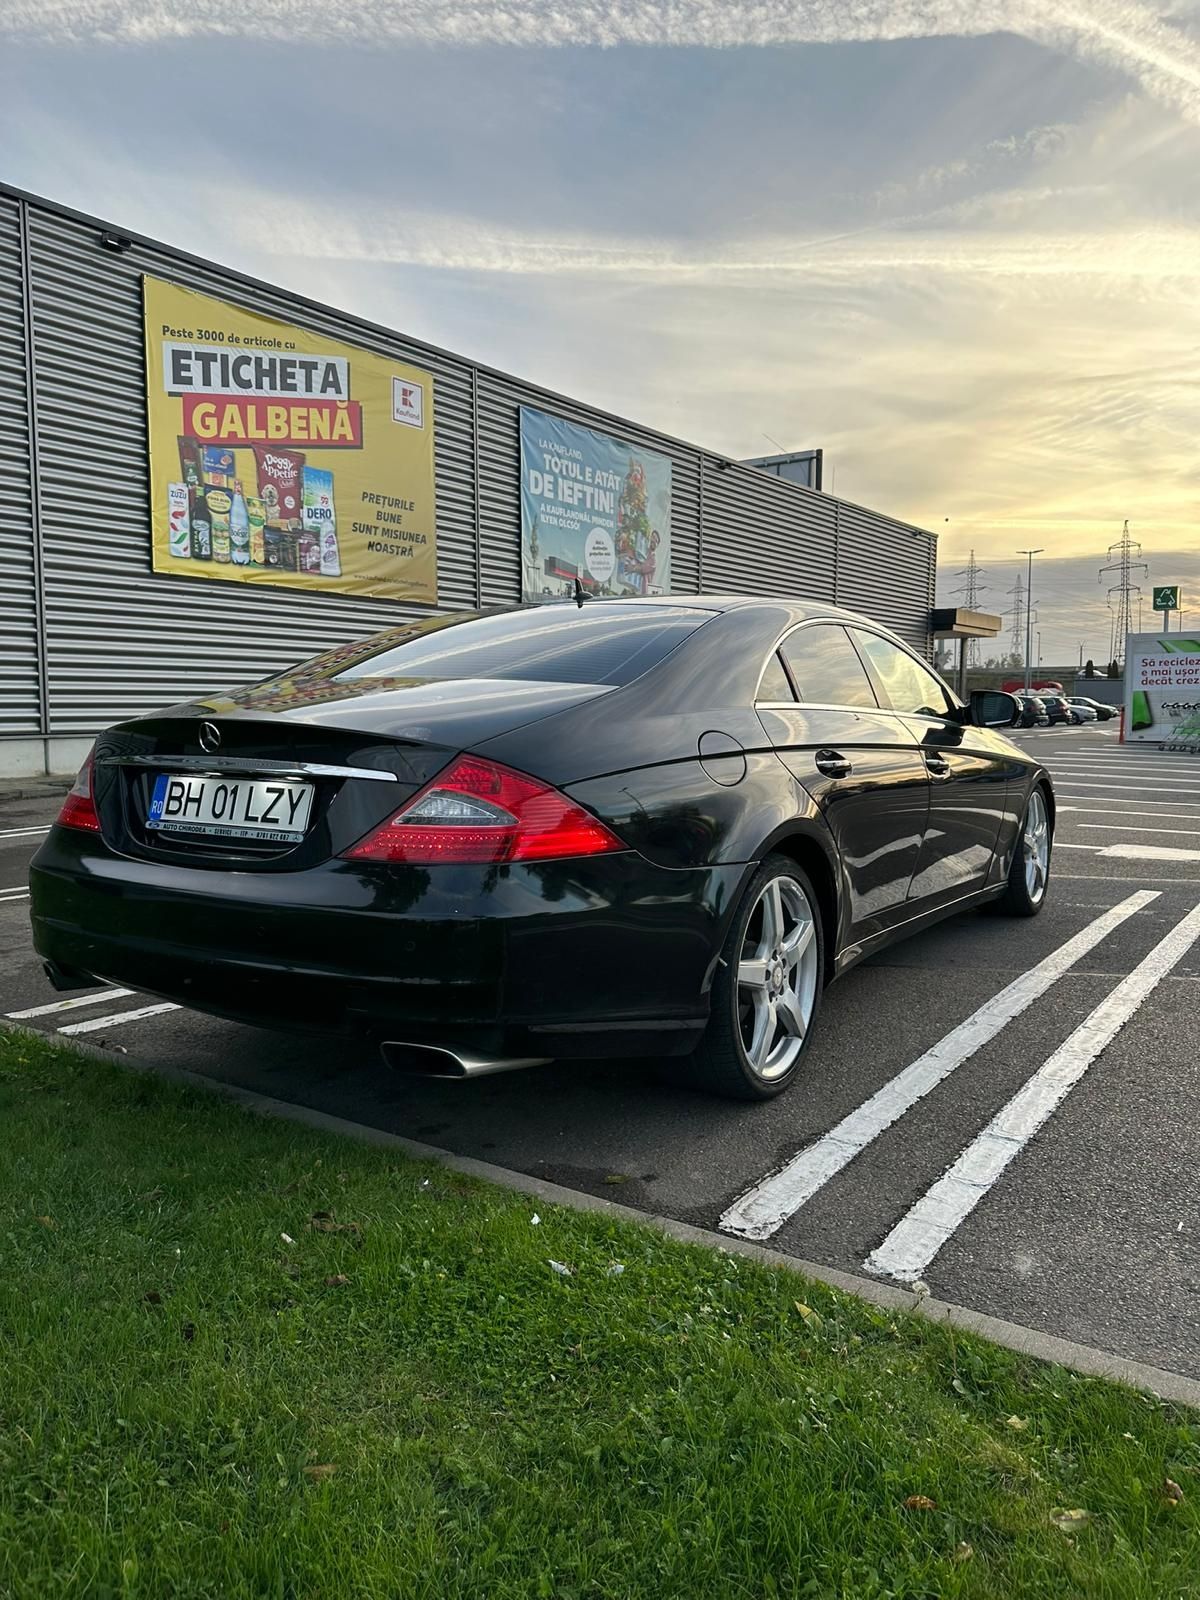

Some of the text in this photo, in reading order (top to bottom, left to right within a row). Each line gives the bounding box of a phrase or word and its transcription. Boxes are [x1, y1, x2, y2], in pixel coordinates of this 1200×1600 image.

[162, 325, 296, 349] Peste 3000 de articole cu
[171, 348, 342, 395] ETICHETA
[192, 400, 354, 441] GALBENĂ
[539, 438, 547, 448] LA
[261, 461, 298, 480] Appetite
[265, 453, 294, 471] Doggy
[543, 453, 620, 491] TOTUL E ATÂT
[529, 469, 614, 515] DE IEFTIN!
[362, 491, 415, 512] PREȚURILE
[307, 508, 332, 519] DERO
[376, 511, 402, 524] BUNE
[352, 522, 427, 544] SUNT MISIUNEA
[367, 541, 414, 557] NOASTRĂ
[1142, 657, 1200, 667] Să reciclez
[1141, 676, 1200, 686] decât crez
[1151, 667, 1171, 676] mai
[1175, 668, 1199, 677] ușor
[151, 800, 163, 814] RO
[165, 781, 306, 825] BH 01 LZY
[163, 823, 178, 831] AUTO
[214, 828, 232, 836] SERVICE
